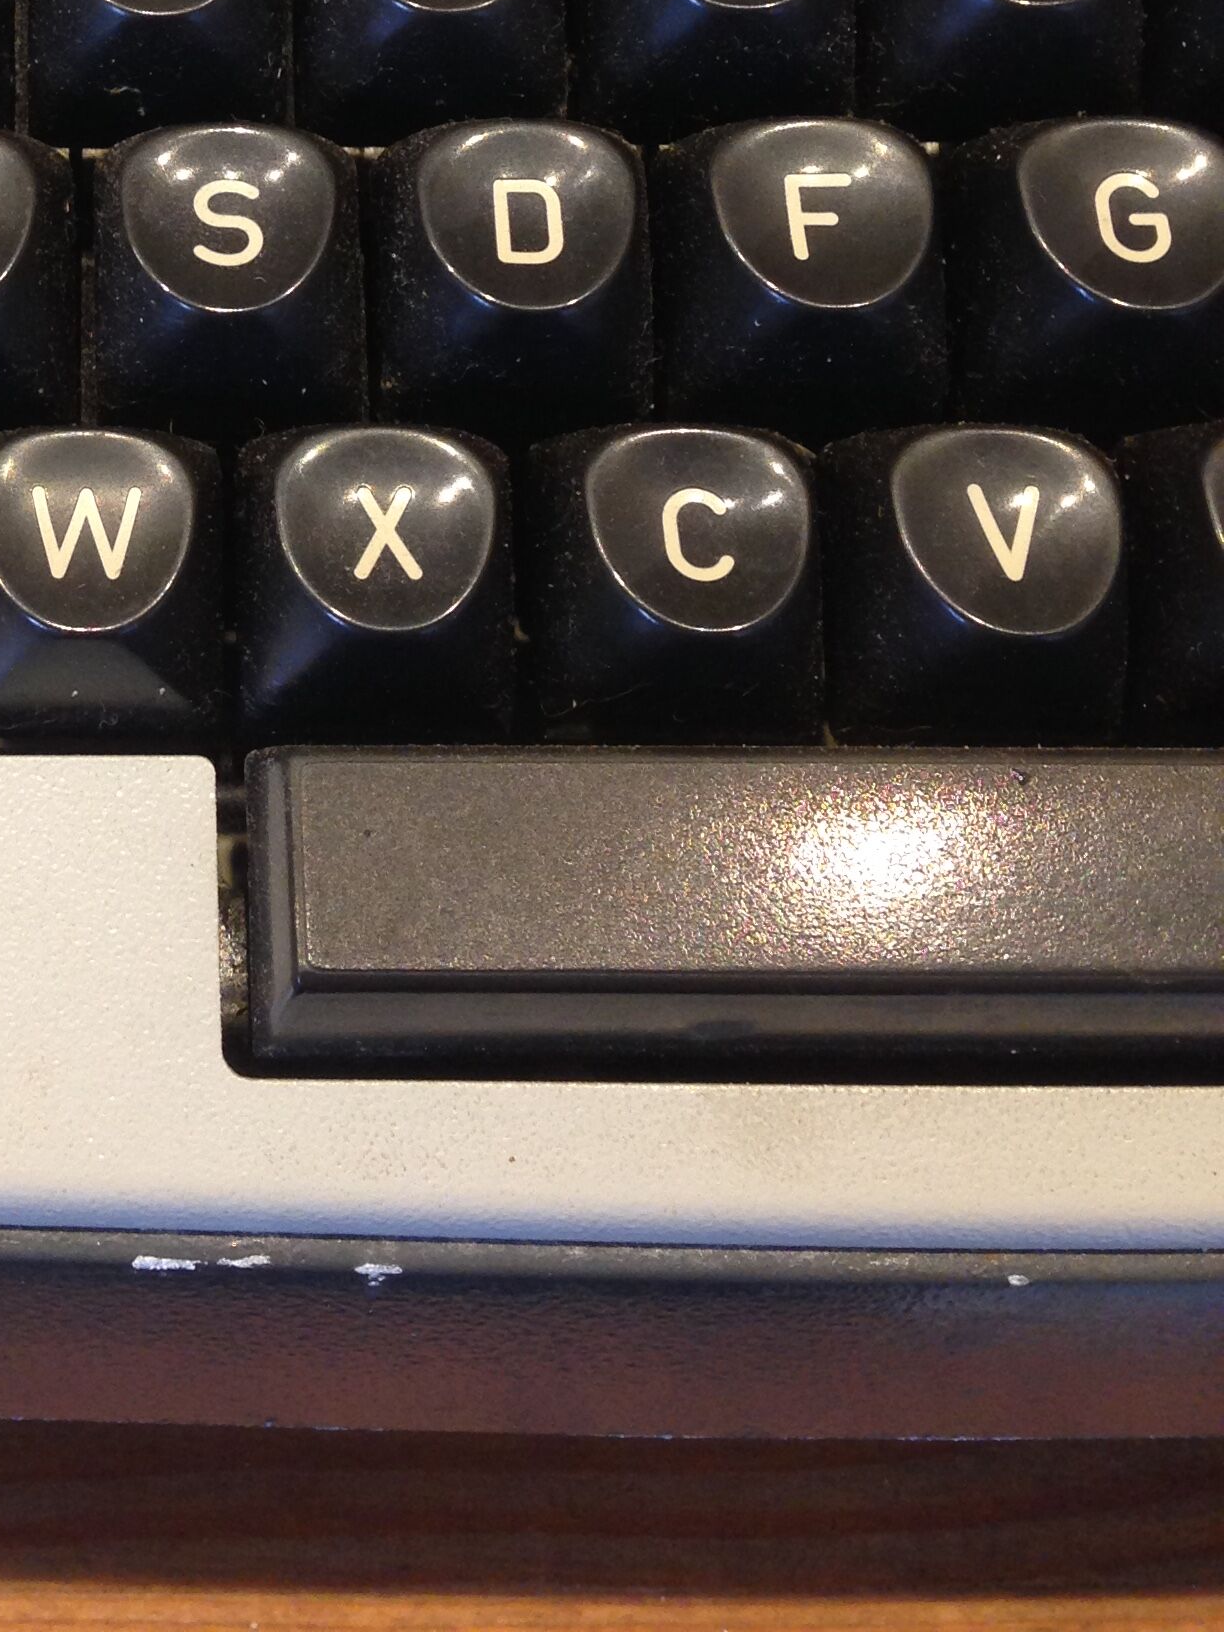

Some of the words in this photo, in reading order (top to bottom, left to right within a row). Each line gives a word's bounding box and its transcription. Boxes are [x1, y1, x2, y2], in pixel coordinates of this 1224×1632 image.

[193, 179, 264, 267] S
[493, 179, 564, 264] D
[784, 173, 852, 260] F
[1094, 172, 1172, 263] G
[31, 485, 141, 580] W
[353, 486, 423, 581] X
[661, 488, 735, 582] C
[967, 484, 1040, 582] V
